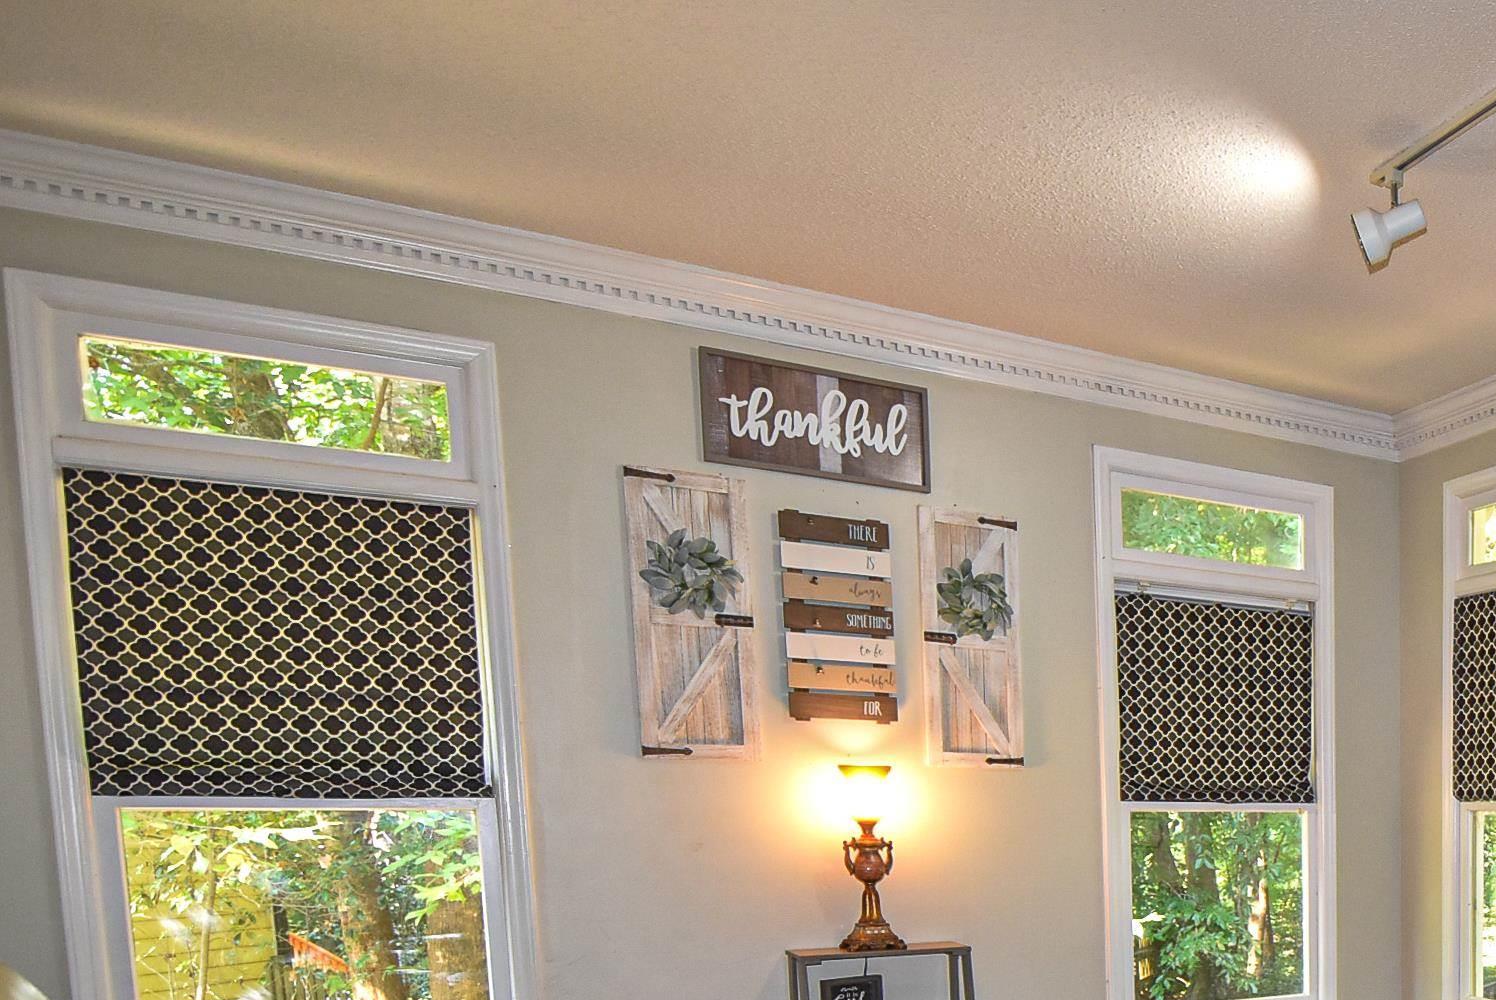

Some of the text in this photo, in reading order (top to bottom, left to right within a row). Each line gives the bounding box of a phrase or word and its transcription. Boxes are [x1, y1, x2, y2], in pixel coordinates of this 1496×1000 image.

[718, 387, 907, 458] thankful
[848, 524, 878, 543] THERE
[866, 556, 875, 570] IS
[846, 613, 892, 630] SOMETHING
[863, 701, 883, 716] FOR
